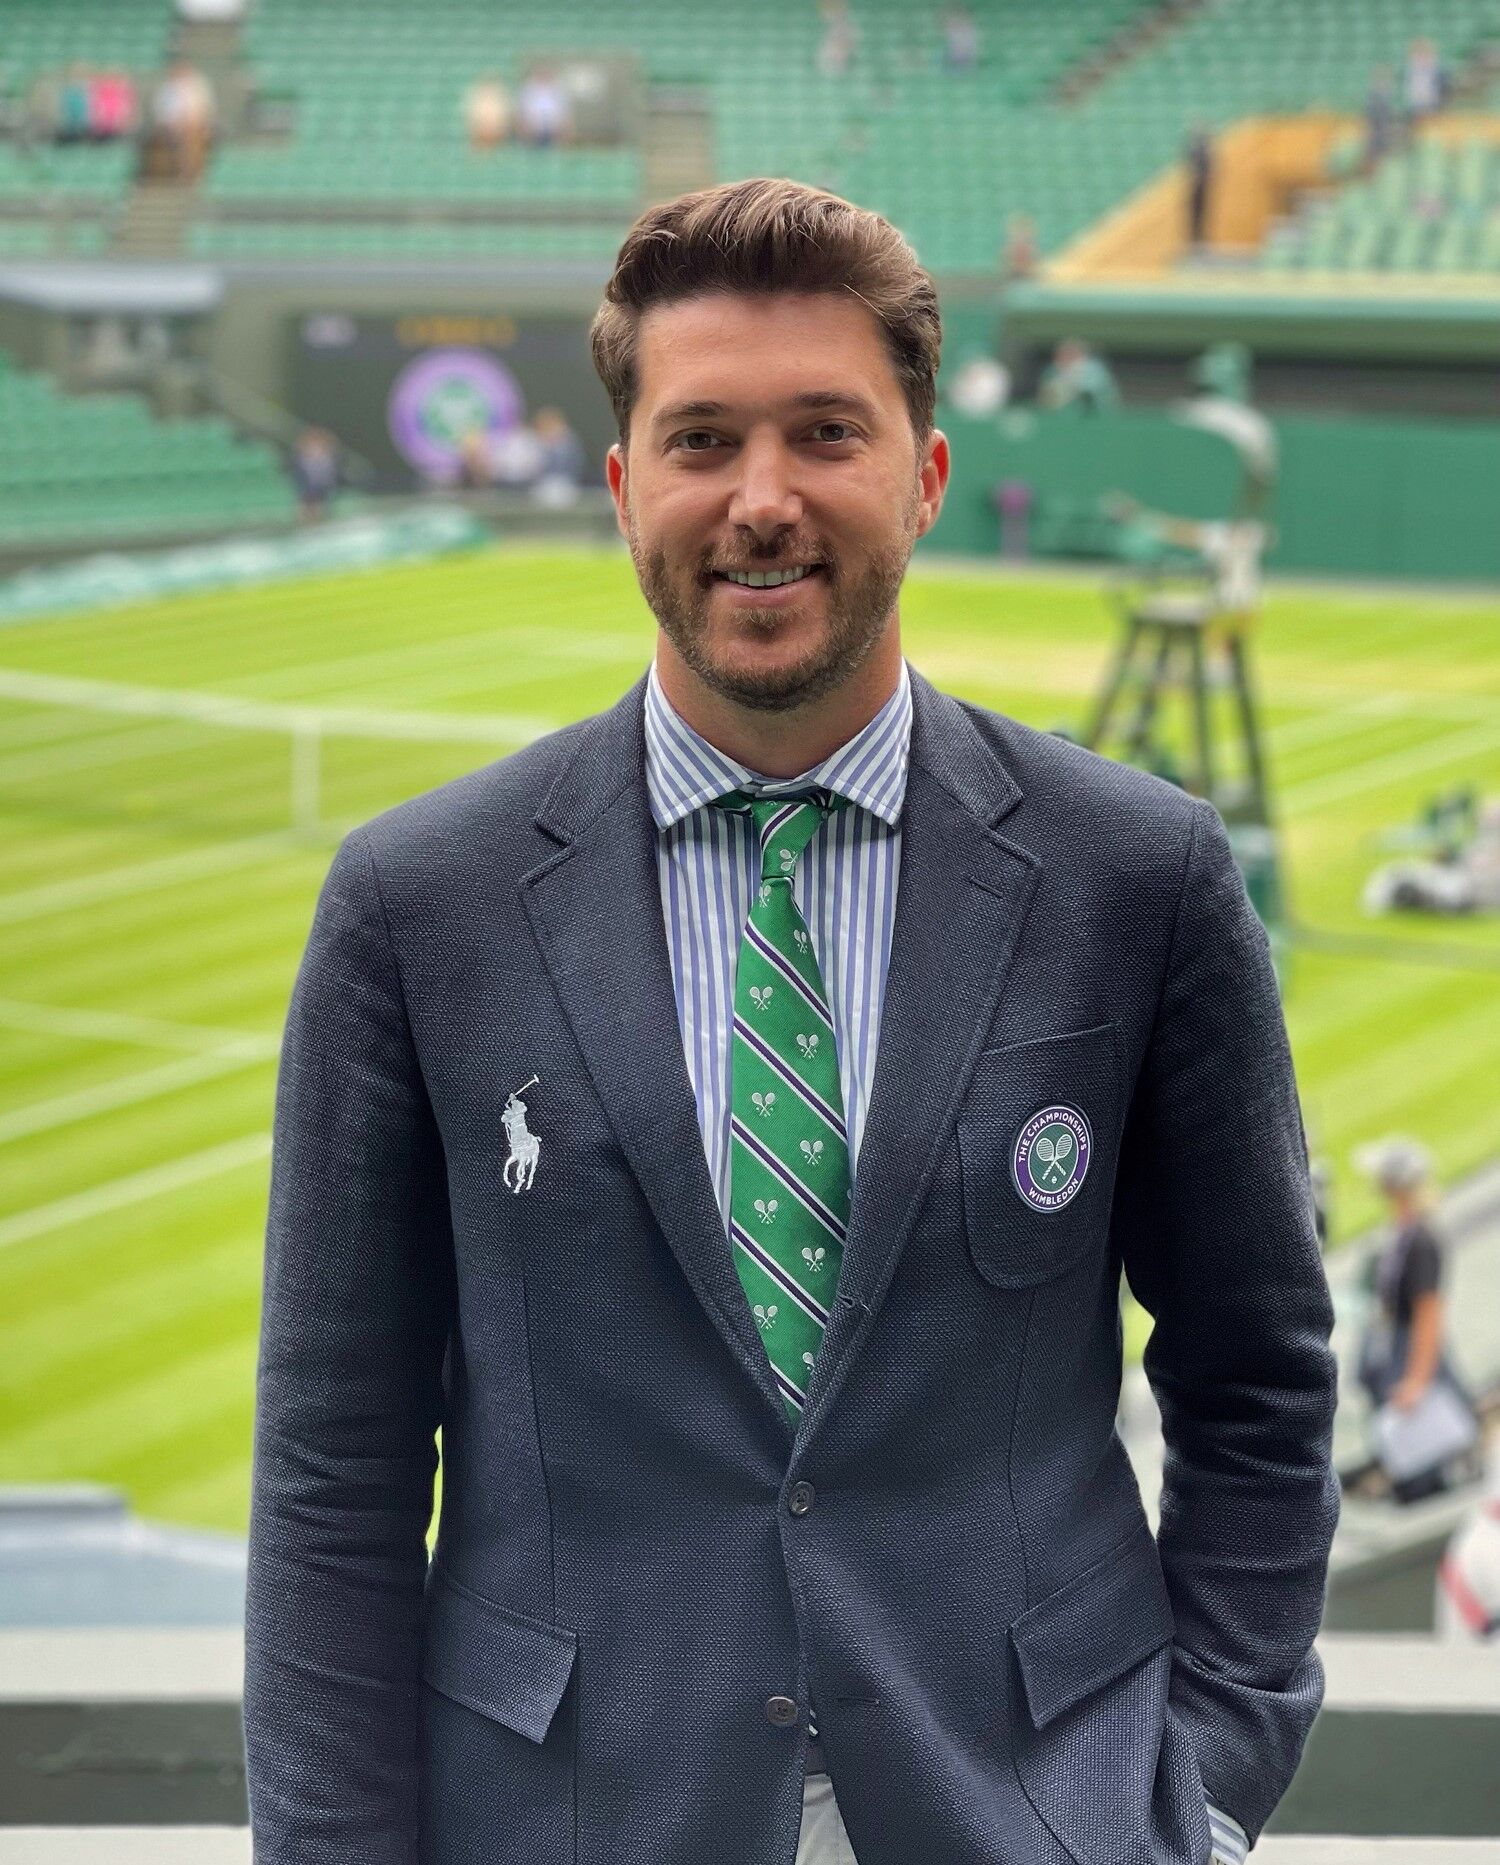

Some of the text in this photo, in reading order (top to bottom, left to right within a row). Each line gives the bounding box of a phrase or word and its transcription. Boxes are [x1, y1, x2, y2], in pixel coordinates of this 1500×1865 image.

[1018, 1112, 1088, 1162] THE CHAMPIONSHIPS
[1028, 1178, 1079, 1205] WIMBLEDON
